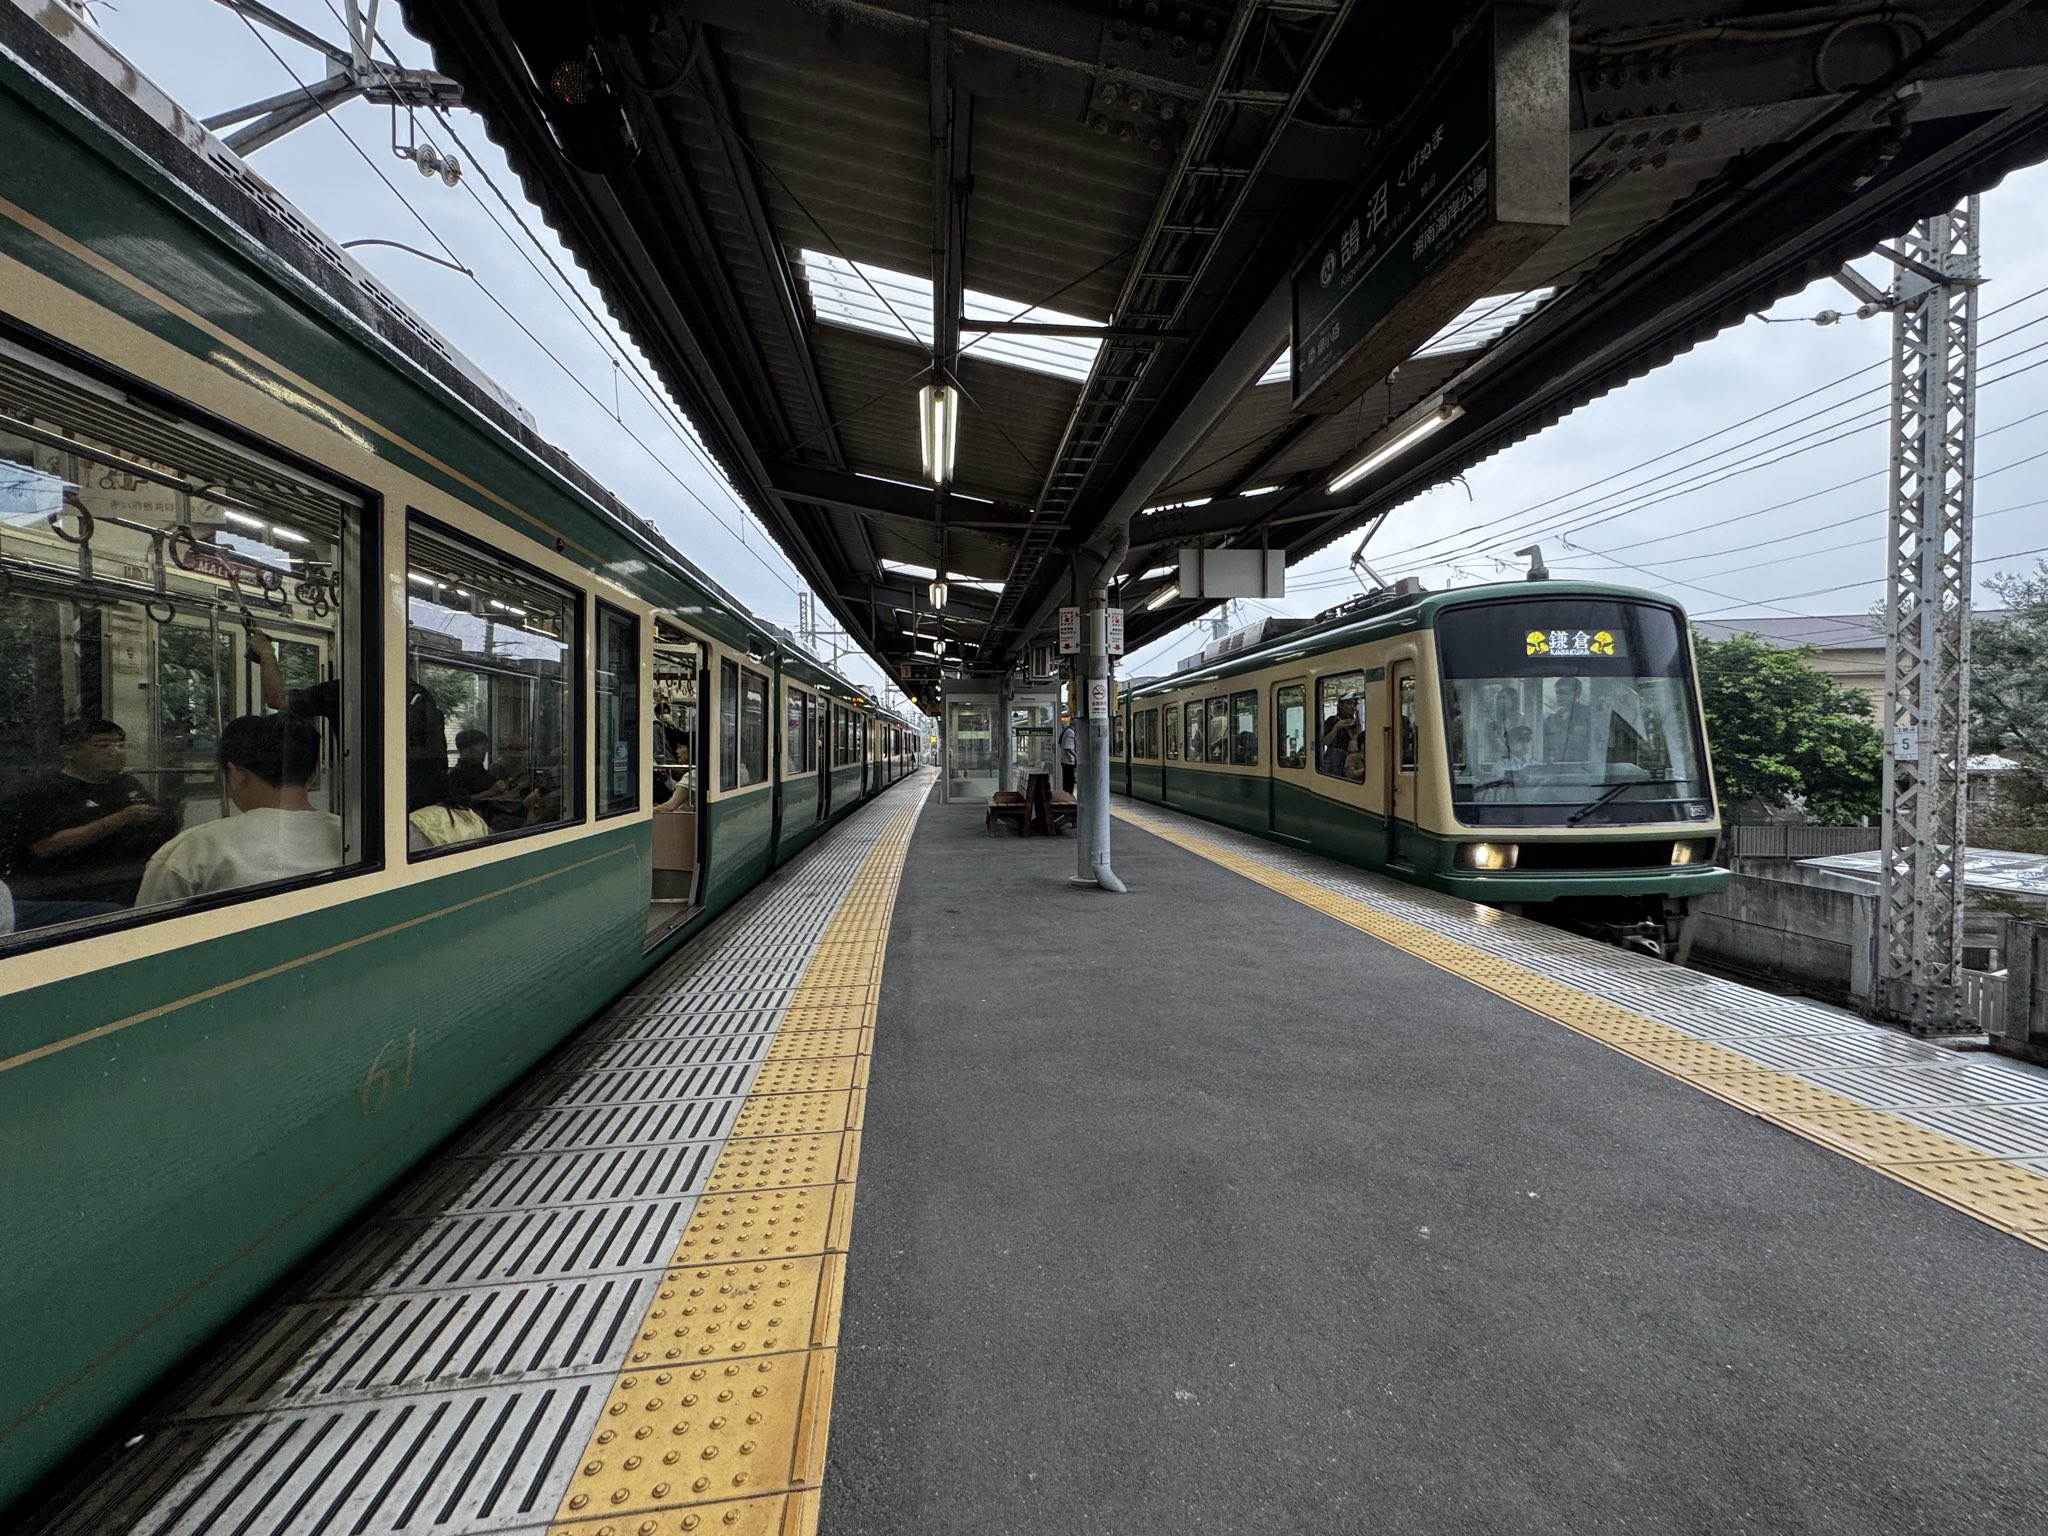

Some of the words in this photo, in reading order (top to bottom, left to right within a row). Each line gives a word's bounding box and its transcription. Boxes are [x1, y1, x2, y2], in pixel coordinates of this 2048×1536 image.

[1397, 122, 1445, 188] くげぬま
[1340, 178, 1388, 270] 鵠沼
[1412, 168, 1487, 261] 湘南海岸公園
[1340, 243, 1376, 289] Kugenuma
[1548, 630, 1591, 650] 鎌倉
[1902, 738, 1910, 751] 5
